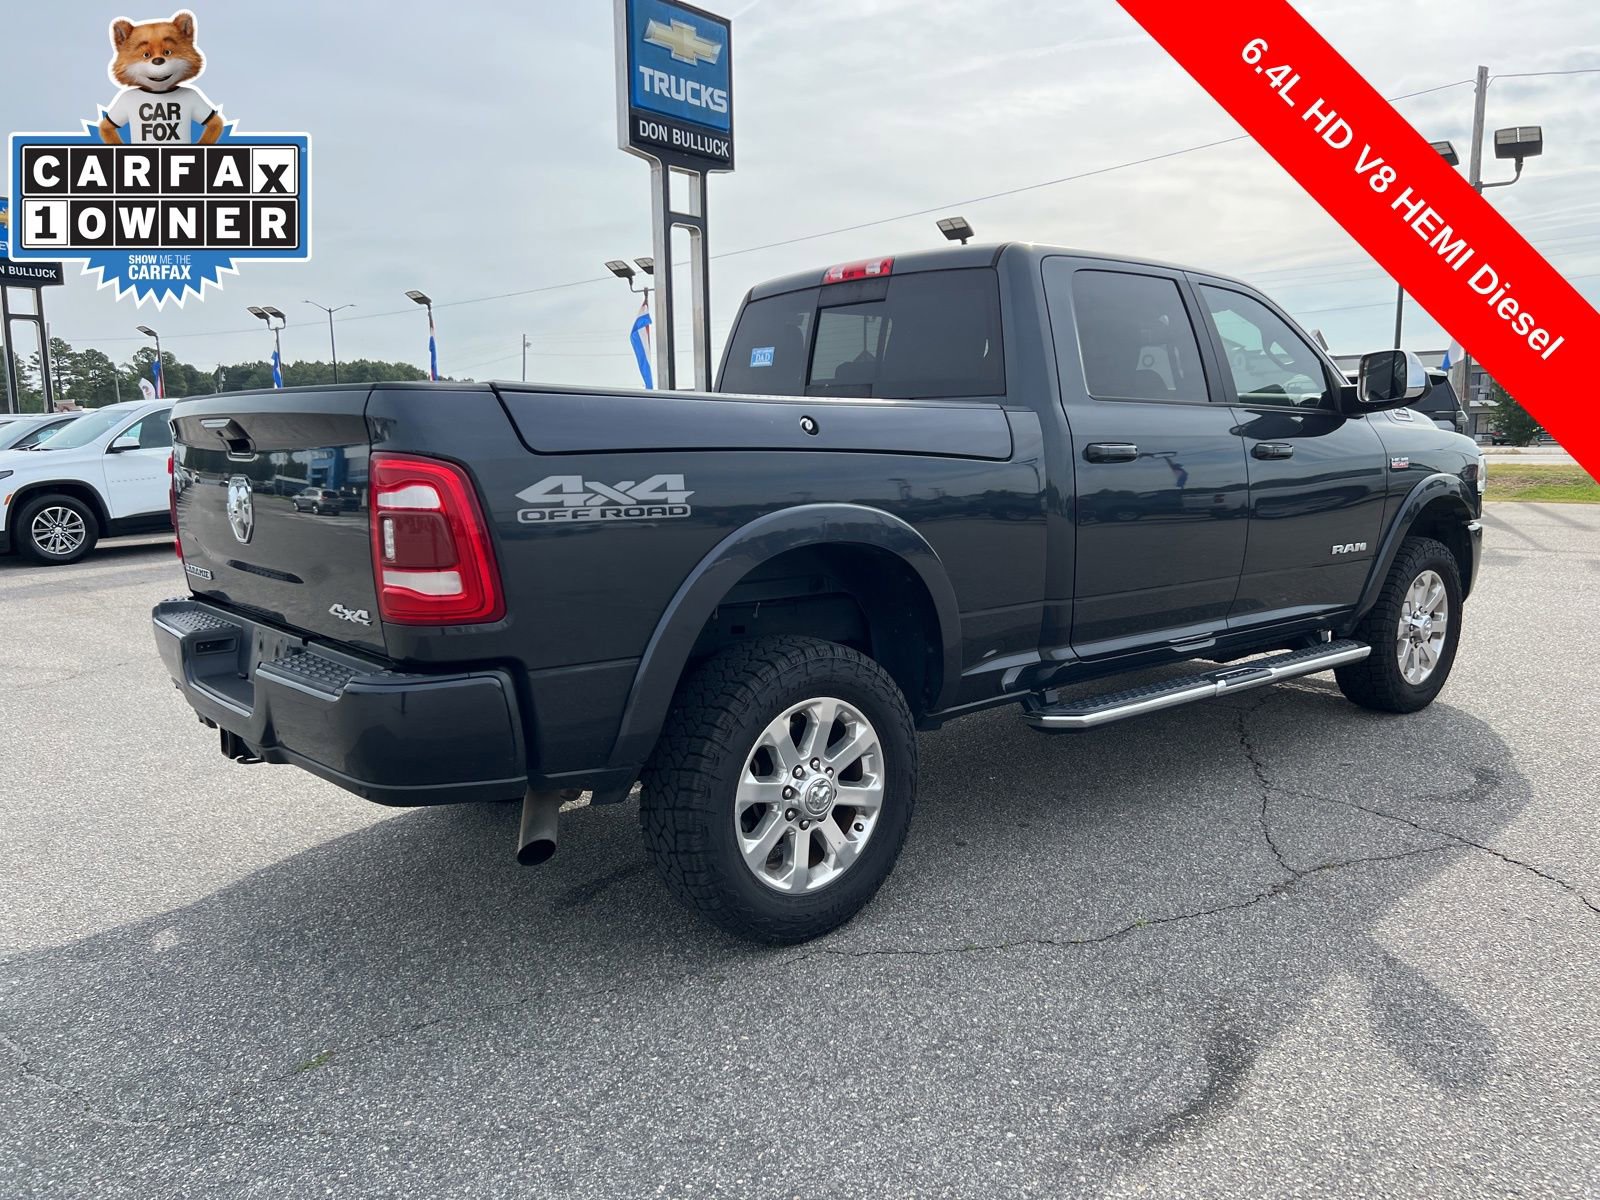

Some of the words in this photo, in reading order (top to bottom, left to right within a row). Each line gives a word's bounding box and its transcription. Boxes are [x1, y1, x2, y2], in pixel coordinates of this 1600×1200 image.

[639, 65, 728, 113] TRUCKS
[639, 119, 668, 142] DON
[672, 128, 730, 158] BULLUCK
[8, 265, 57, 279] BULLUCK
[521, 508, 592, 521] OFF
[600, 505, 688, 519] ROAD
[1331, 542, 1367, 555] RAM
